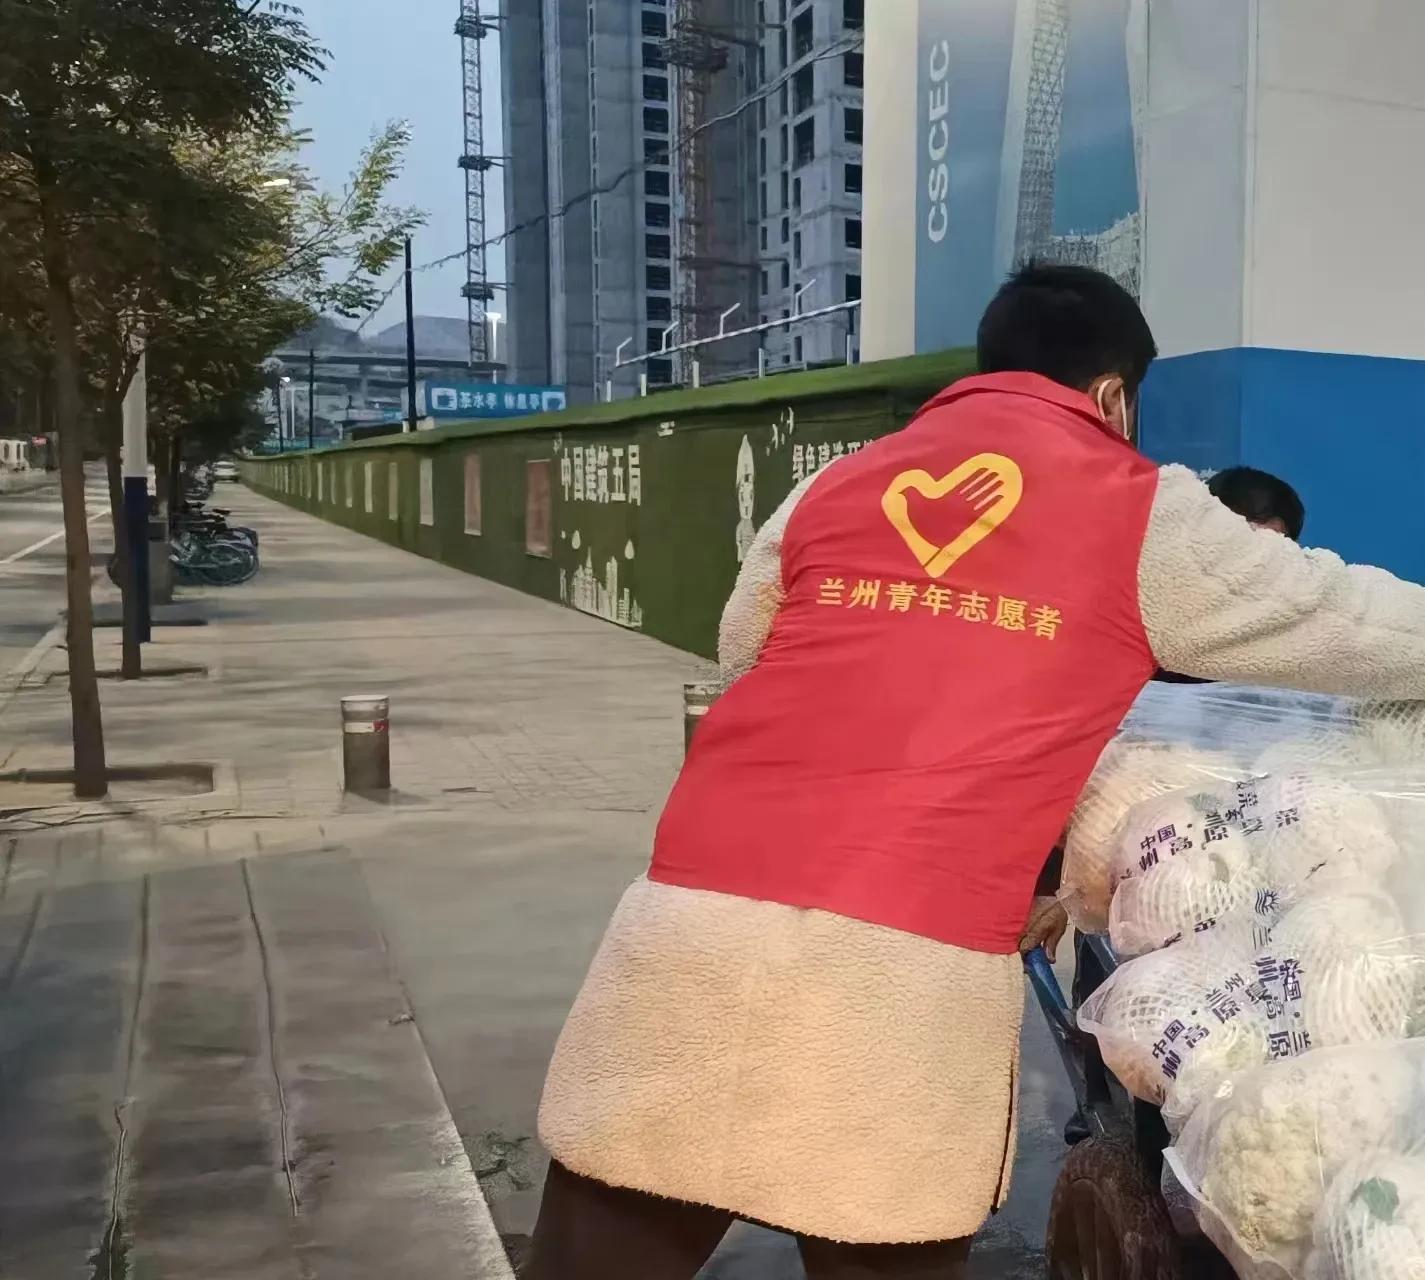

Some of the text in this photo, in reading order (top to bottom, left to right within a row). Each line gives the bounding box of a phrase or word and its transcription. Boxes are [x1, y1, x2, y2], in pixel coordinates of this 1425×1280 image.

[928, 39, 950, 243] CSCEC
[561, 444, 641, 507] 中国建筑五局
[815, 577, 1063, 641] 兰州青年志愿者
